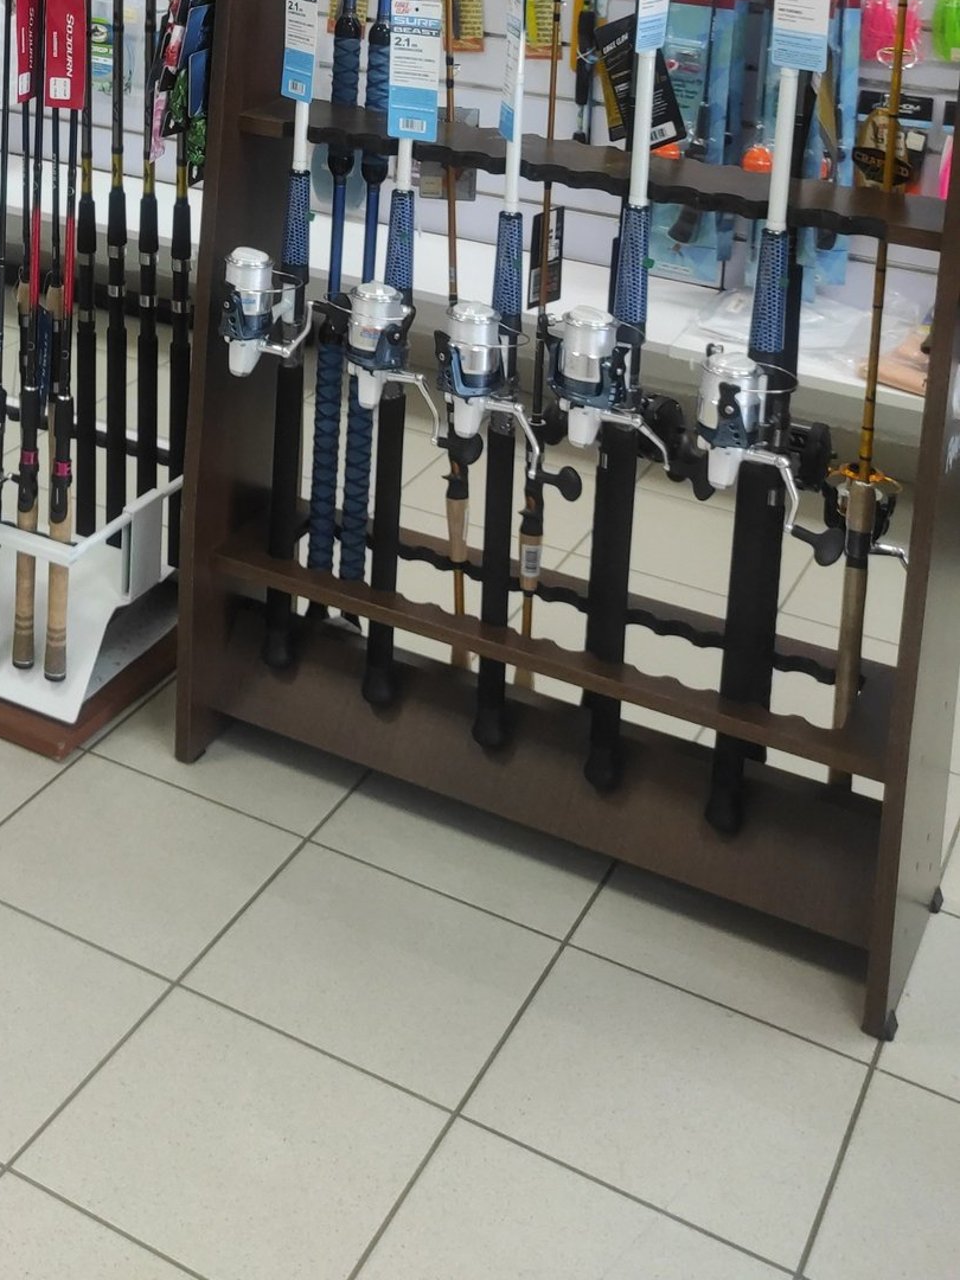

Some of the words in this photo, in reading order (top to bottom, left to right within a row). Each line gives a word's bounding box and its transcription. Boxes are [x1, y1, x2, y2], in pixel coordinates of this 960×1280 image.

[393, 16, 439, 28] SURF
[393, 26, 439, 36] BEAST
[65, 13, 76, 78] SOJOURN
